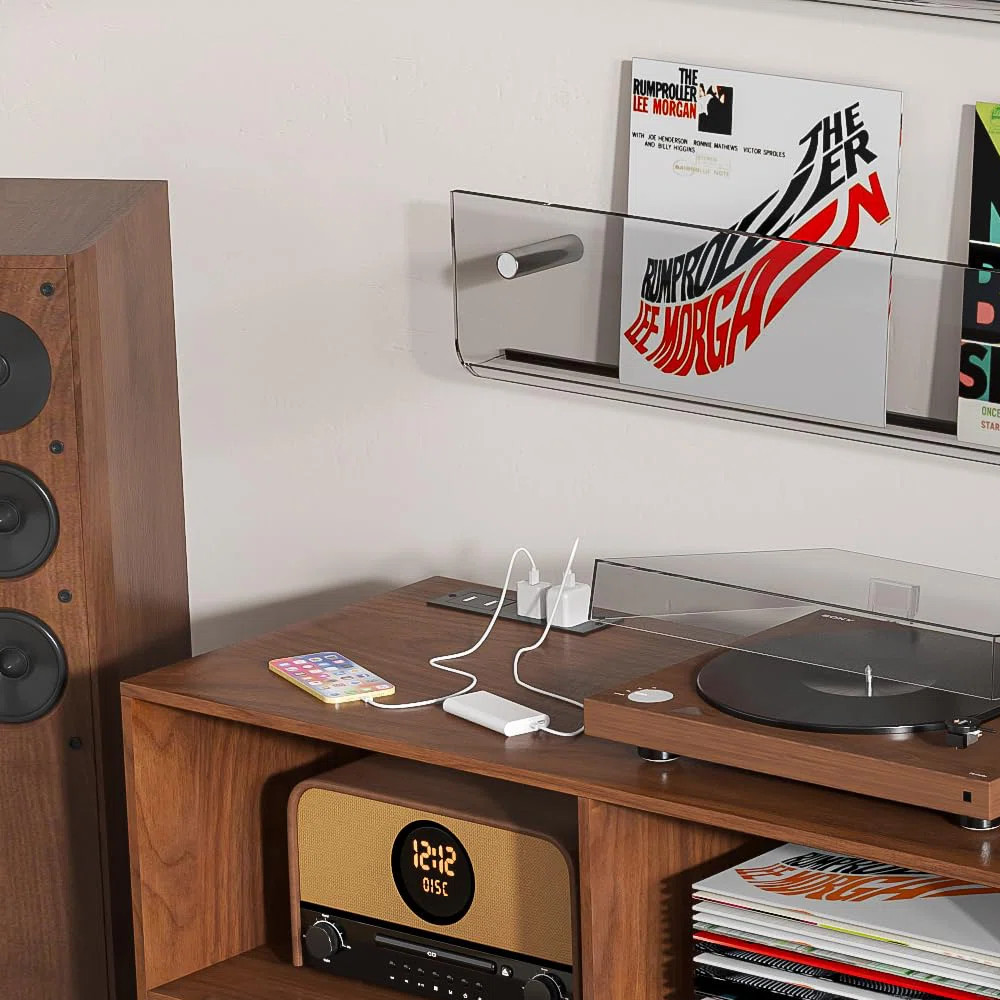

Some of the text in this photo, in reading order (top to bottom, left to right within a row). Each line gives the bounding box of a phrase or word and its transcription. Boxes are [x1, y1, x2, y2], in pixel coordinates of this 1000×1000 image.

[679, 67, 698, 86] THE
[633, 78, 697, 102] RUMPROLLER
[633, 95, 696, 120] LEE MORGAN
[632, 131, 644, 139] WITH
[658, 135, 688, 145] HENDERSON
[693, 139, 712, 148] RONNIE
[714, 142, 738, 152] MATHEWS
[743, 146, 762, 155] VICTOR
[763, 149, 786, 158] SPROLES
[644, 140, 696, 153] AND BILLY HIGGINS
[793, 101, 865, 176] THE
[624, 299, 660, 355] LEE
[982, 406, 1000, 420] ONCE
[412, 839, 457, 877] 12:12
